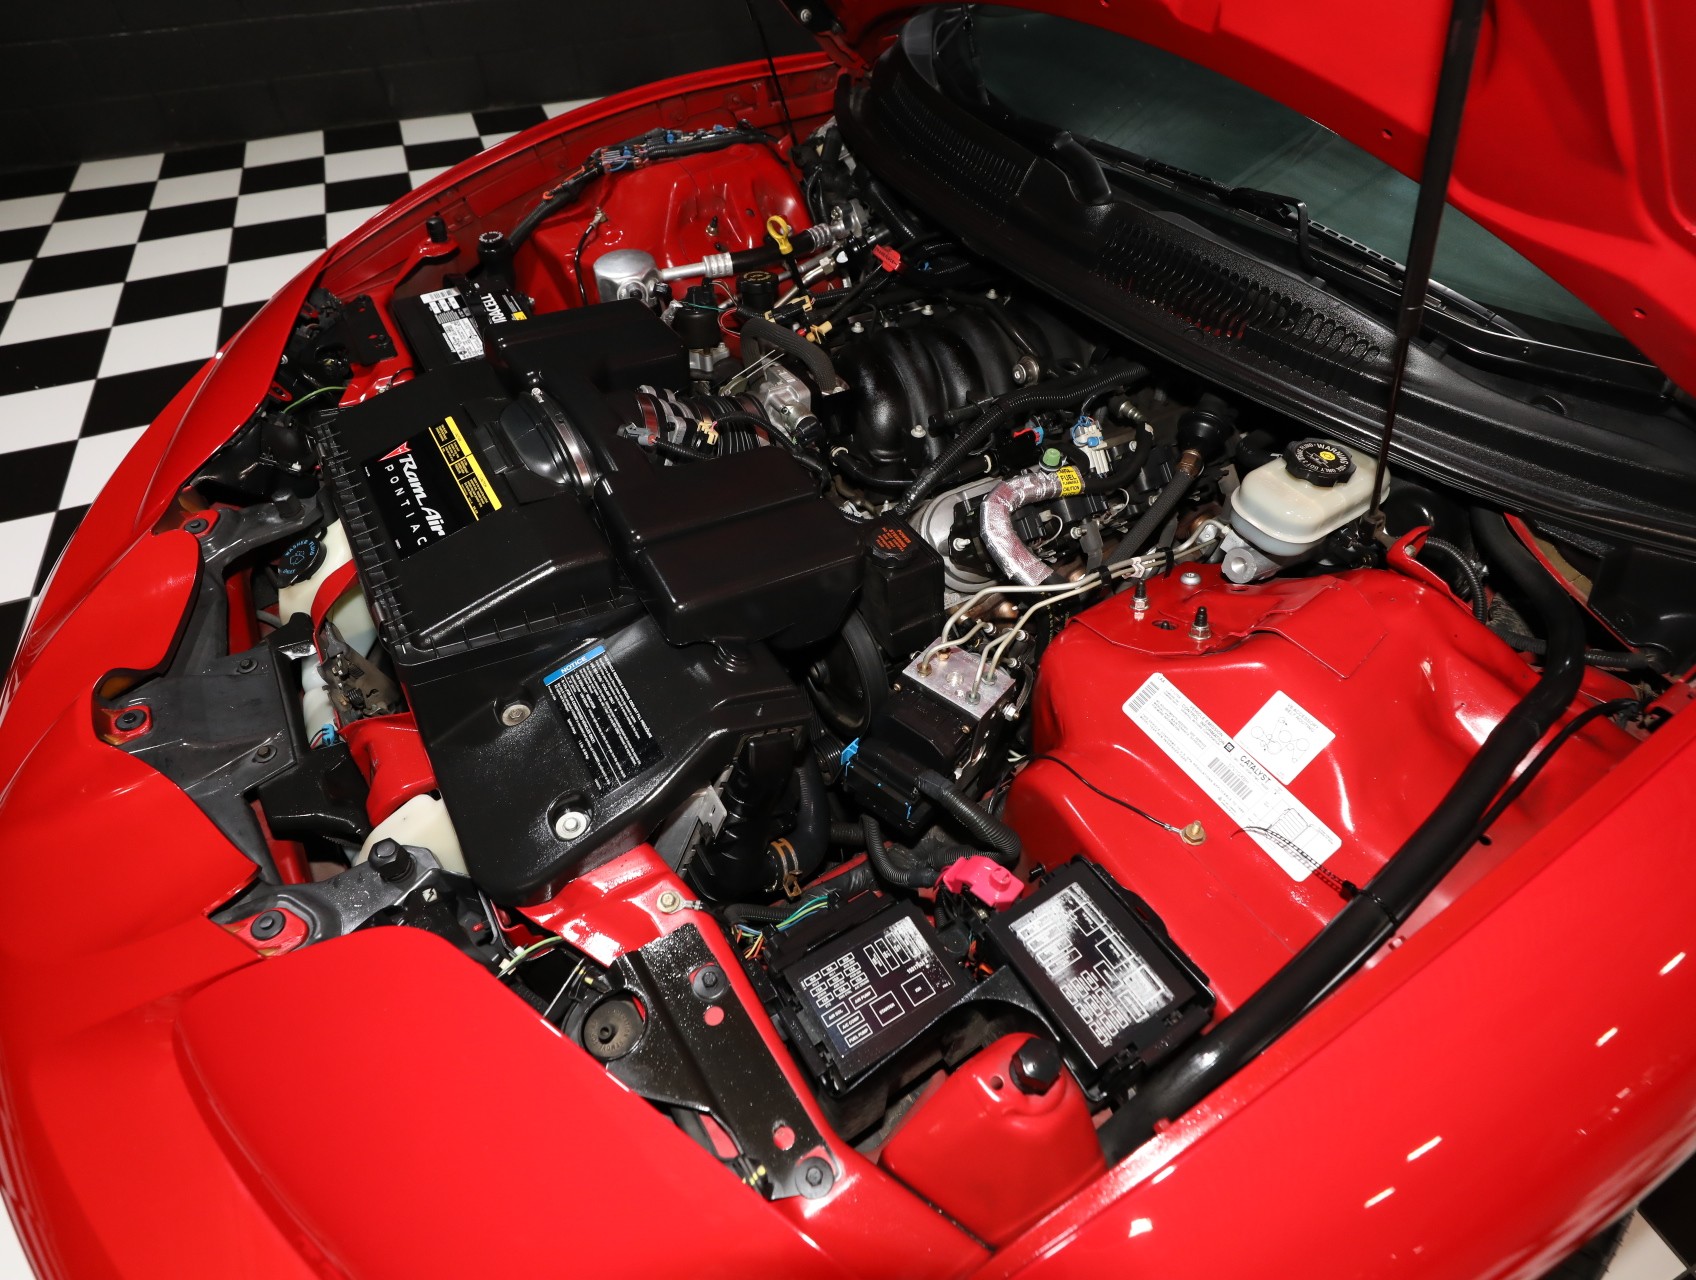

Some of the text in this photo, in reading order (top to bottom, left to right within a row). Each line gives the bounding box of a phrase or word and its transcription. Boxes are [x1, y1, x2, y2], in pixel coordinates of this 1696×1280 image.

[1316, 443, 1348, 464] WARNING
[384, 464, 428, 546] PONTIAC
[398, 453, 446, 537] Ram Air
[560, 655, 587, 674] NOTICE
[1181, 704, 1226, 745] CONTROL INFORMATION
[1189, 705, 1224, 738] VEHICLE EMISSION
[1284, 707, 1315, 733] BELT ROUTING
[1293, 708, 1319, 730] ACCESSORY
[1240, 755, 1271, 784] CATALYST
[860, 990, 872, 1000] PUMP
[827, 1013, 836, 1021] AIR
[878, 1002, 896, 1015] STARTER
[848, 1028, 869, 1043] FUEL PUMP
